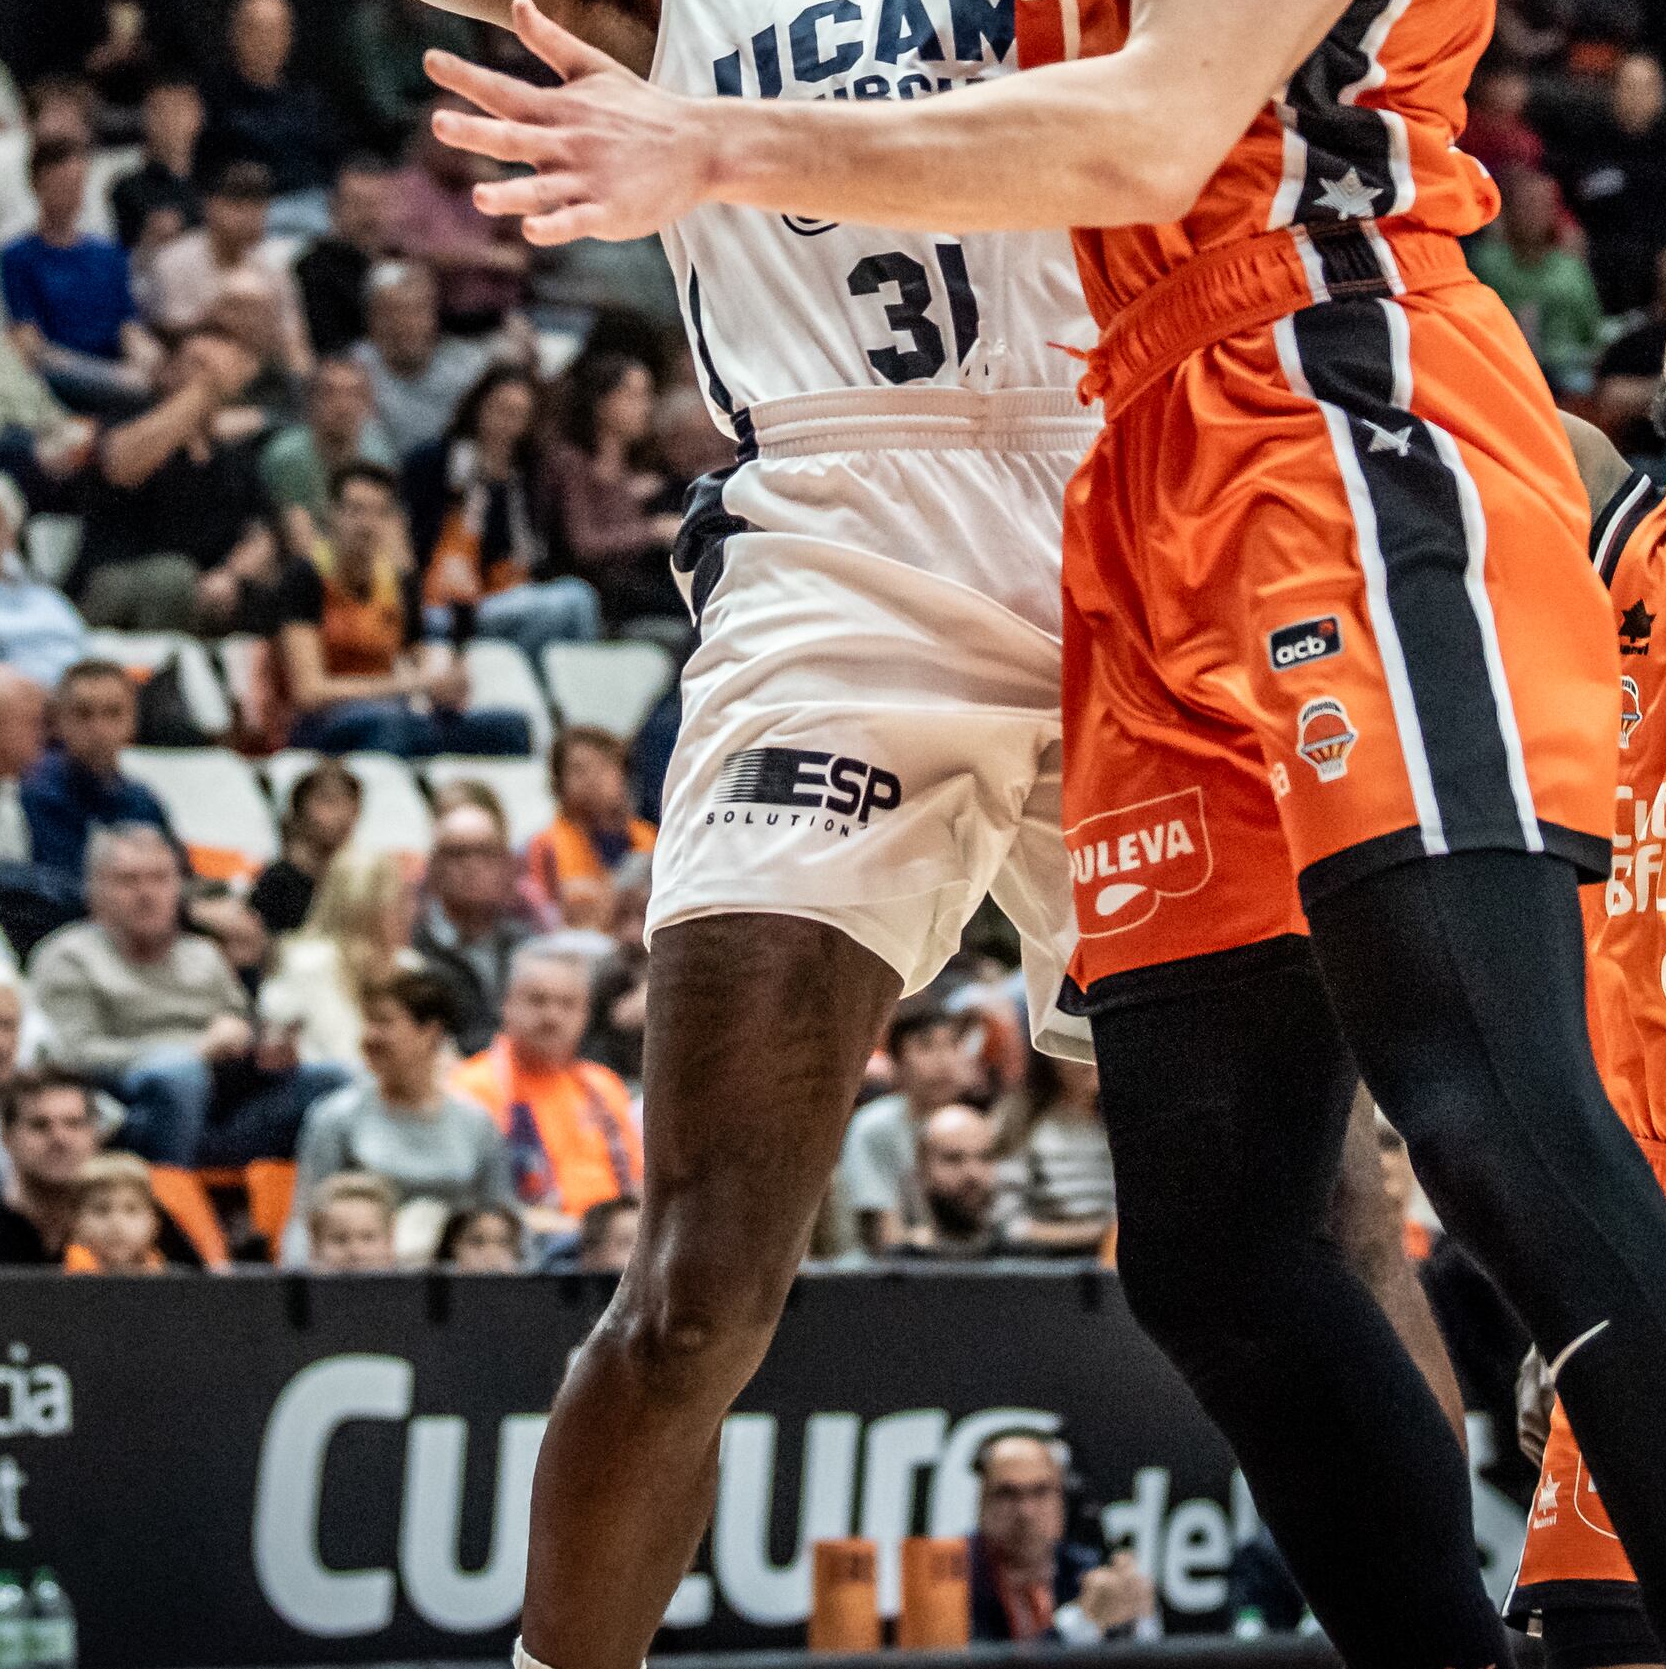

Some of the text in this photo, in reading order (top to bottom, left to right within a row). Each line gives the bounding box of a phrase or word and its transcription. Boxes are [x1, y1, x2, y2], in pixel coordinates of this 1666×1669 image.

[848, 243, 979, 386] 31
[1275, 632, 1327, 665] acb
[761, 747, 903, 822] ESP
